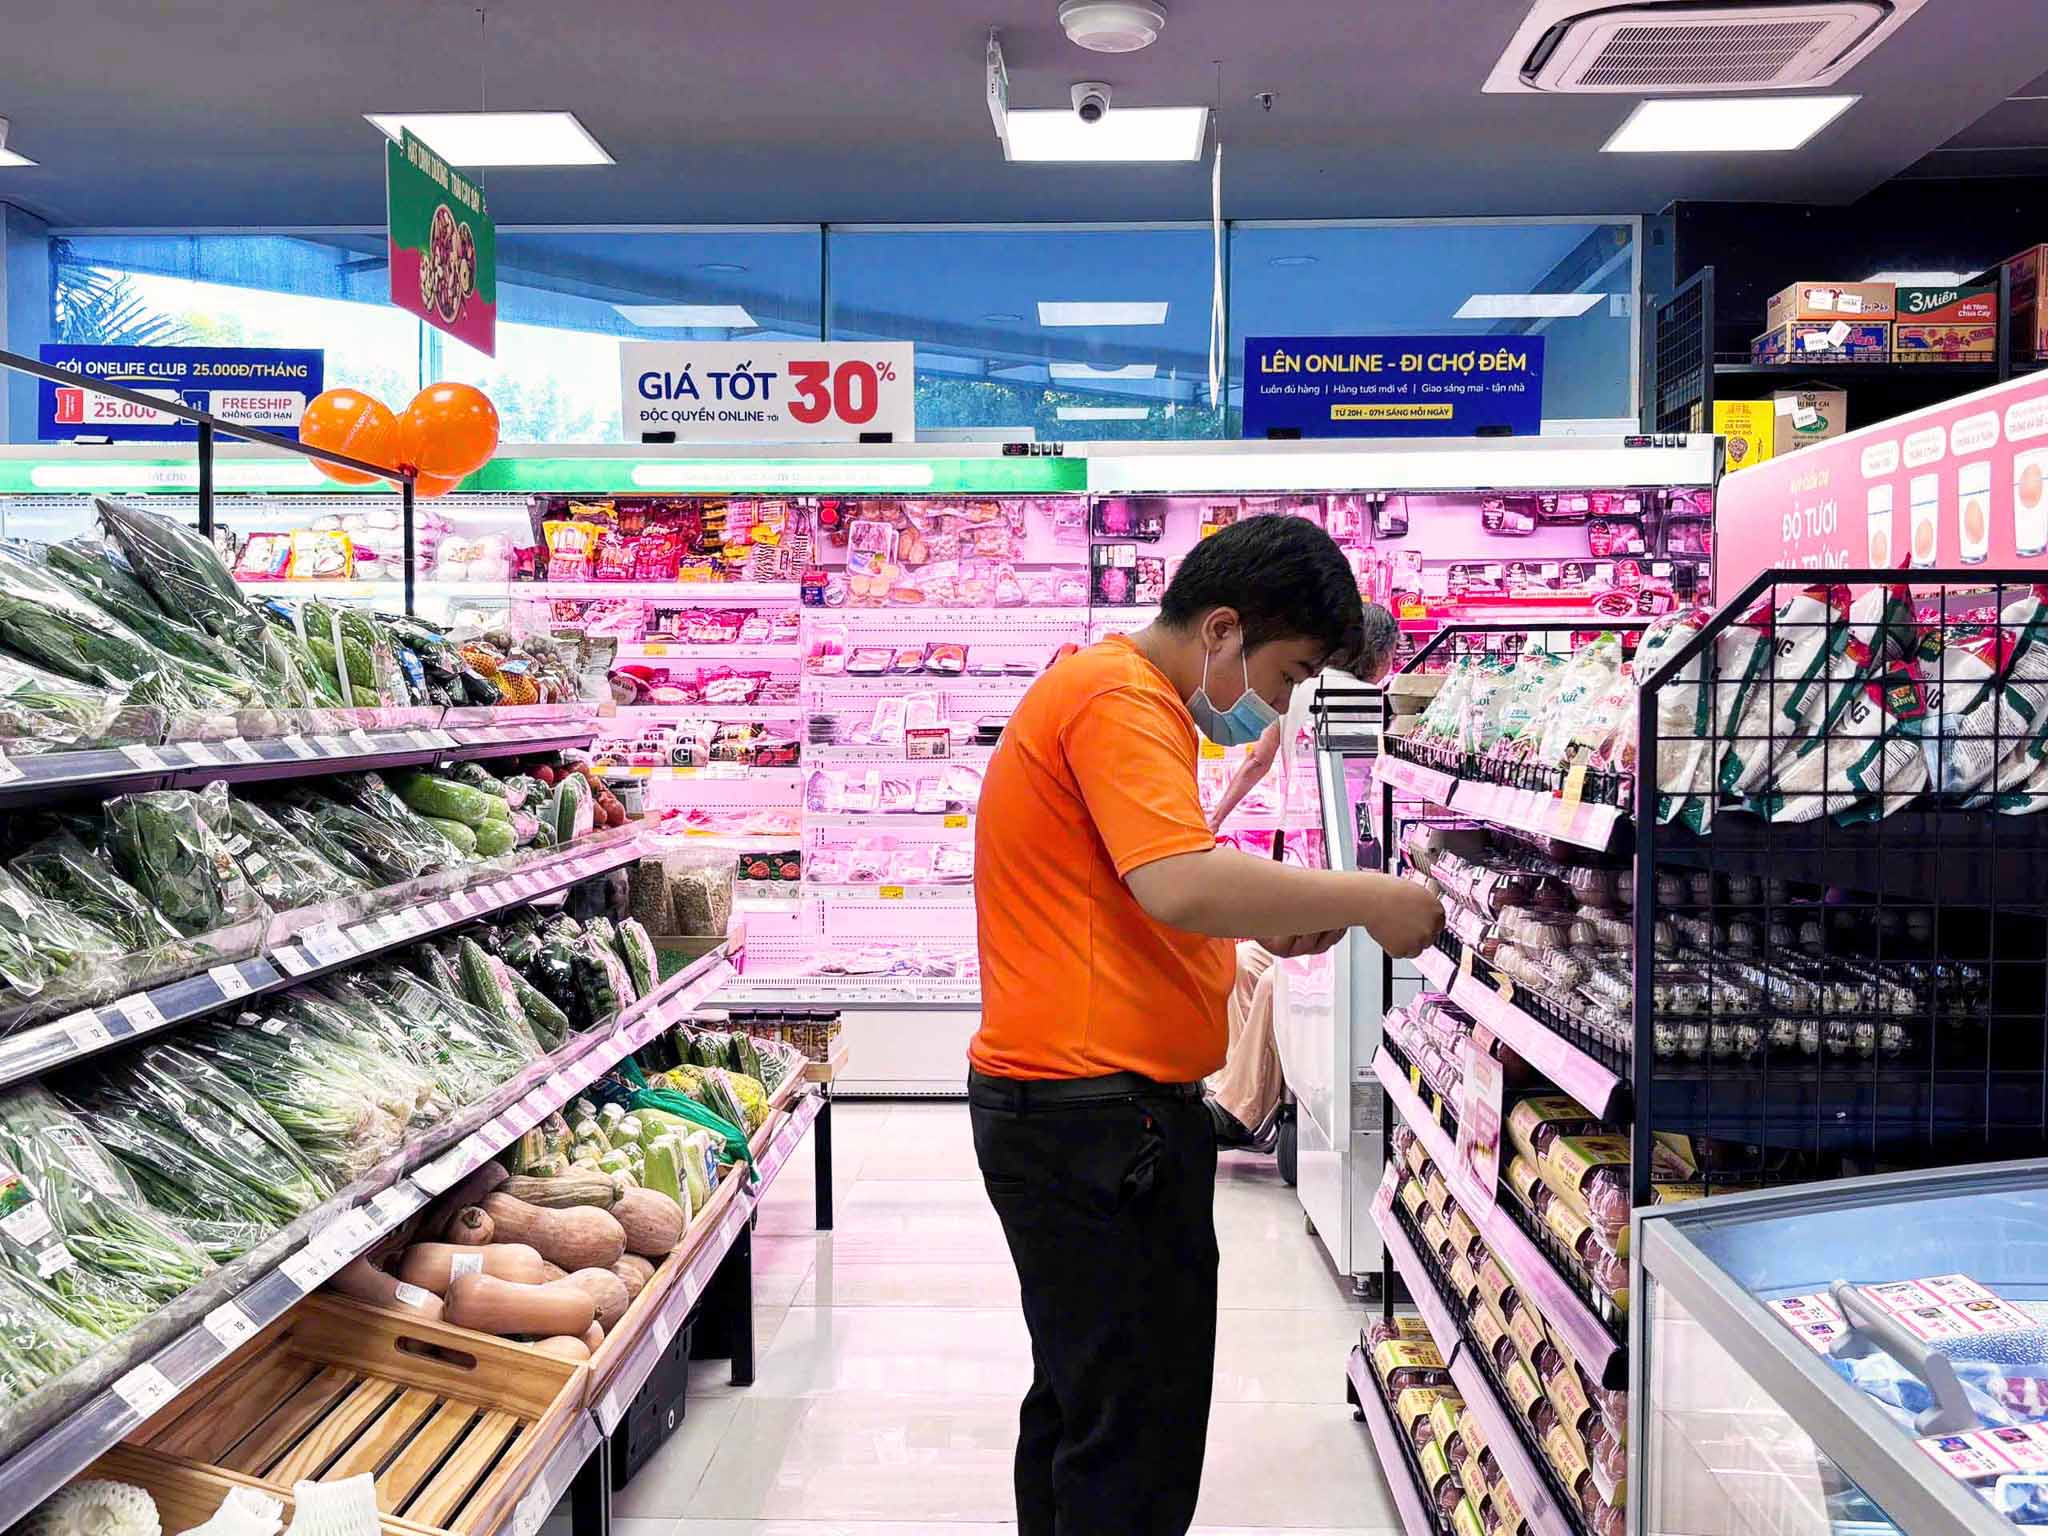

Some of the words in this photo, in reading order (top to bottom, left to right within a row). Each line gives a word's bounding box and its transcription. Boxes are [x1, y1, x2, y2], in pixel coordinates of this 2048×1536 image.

[1261, 349, 1301, 373] LÊN
[1305, 354, 1383, 373] ONLINE
[1400, 354, 1423, 372] ĐI
[1427, 350, 1476, 376] CHỢ
[1478, 347, 1527, 372] ĐÊM
[86, 361, 145, 374] ONELIFE
[149, 362, 187, 375] CLUB
[193, 361, 308, 377] 25.000Đ/THÁNG
[638, 362, 700, 400] GIÁ
[706, 360, 778, 400] TỐT
[1260, 384, 1282, 394] Luôn
[1284, 384, 1296, 394] đủ
[1298, 384, 1320, 396] hàng
[1333, 384, 1358, 396] Hàng
[1421, 383, 1442, 393] Giao
[1443, 383, 1465, 395] sáng
[1508, 381, 1525, 393] nhà
[222, 397, 293, 409] FREESHIP
[222, 411, 252, 420] KHÔNG
[640, 407, 669, 424] ĐỘC
[718, 410, 765, 421] ONLINE
[1347, 409, 1362, 417] 20H
[1369, 409, 1384, 417] 07H
[1386, 408, 1408, 417] SÁNG
[1427, 407, 1449, 417] NGÀY
